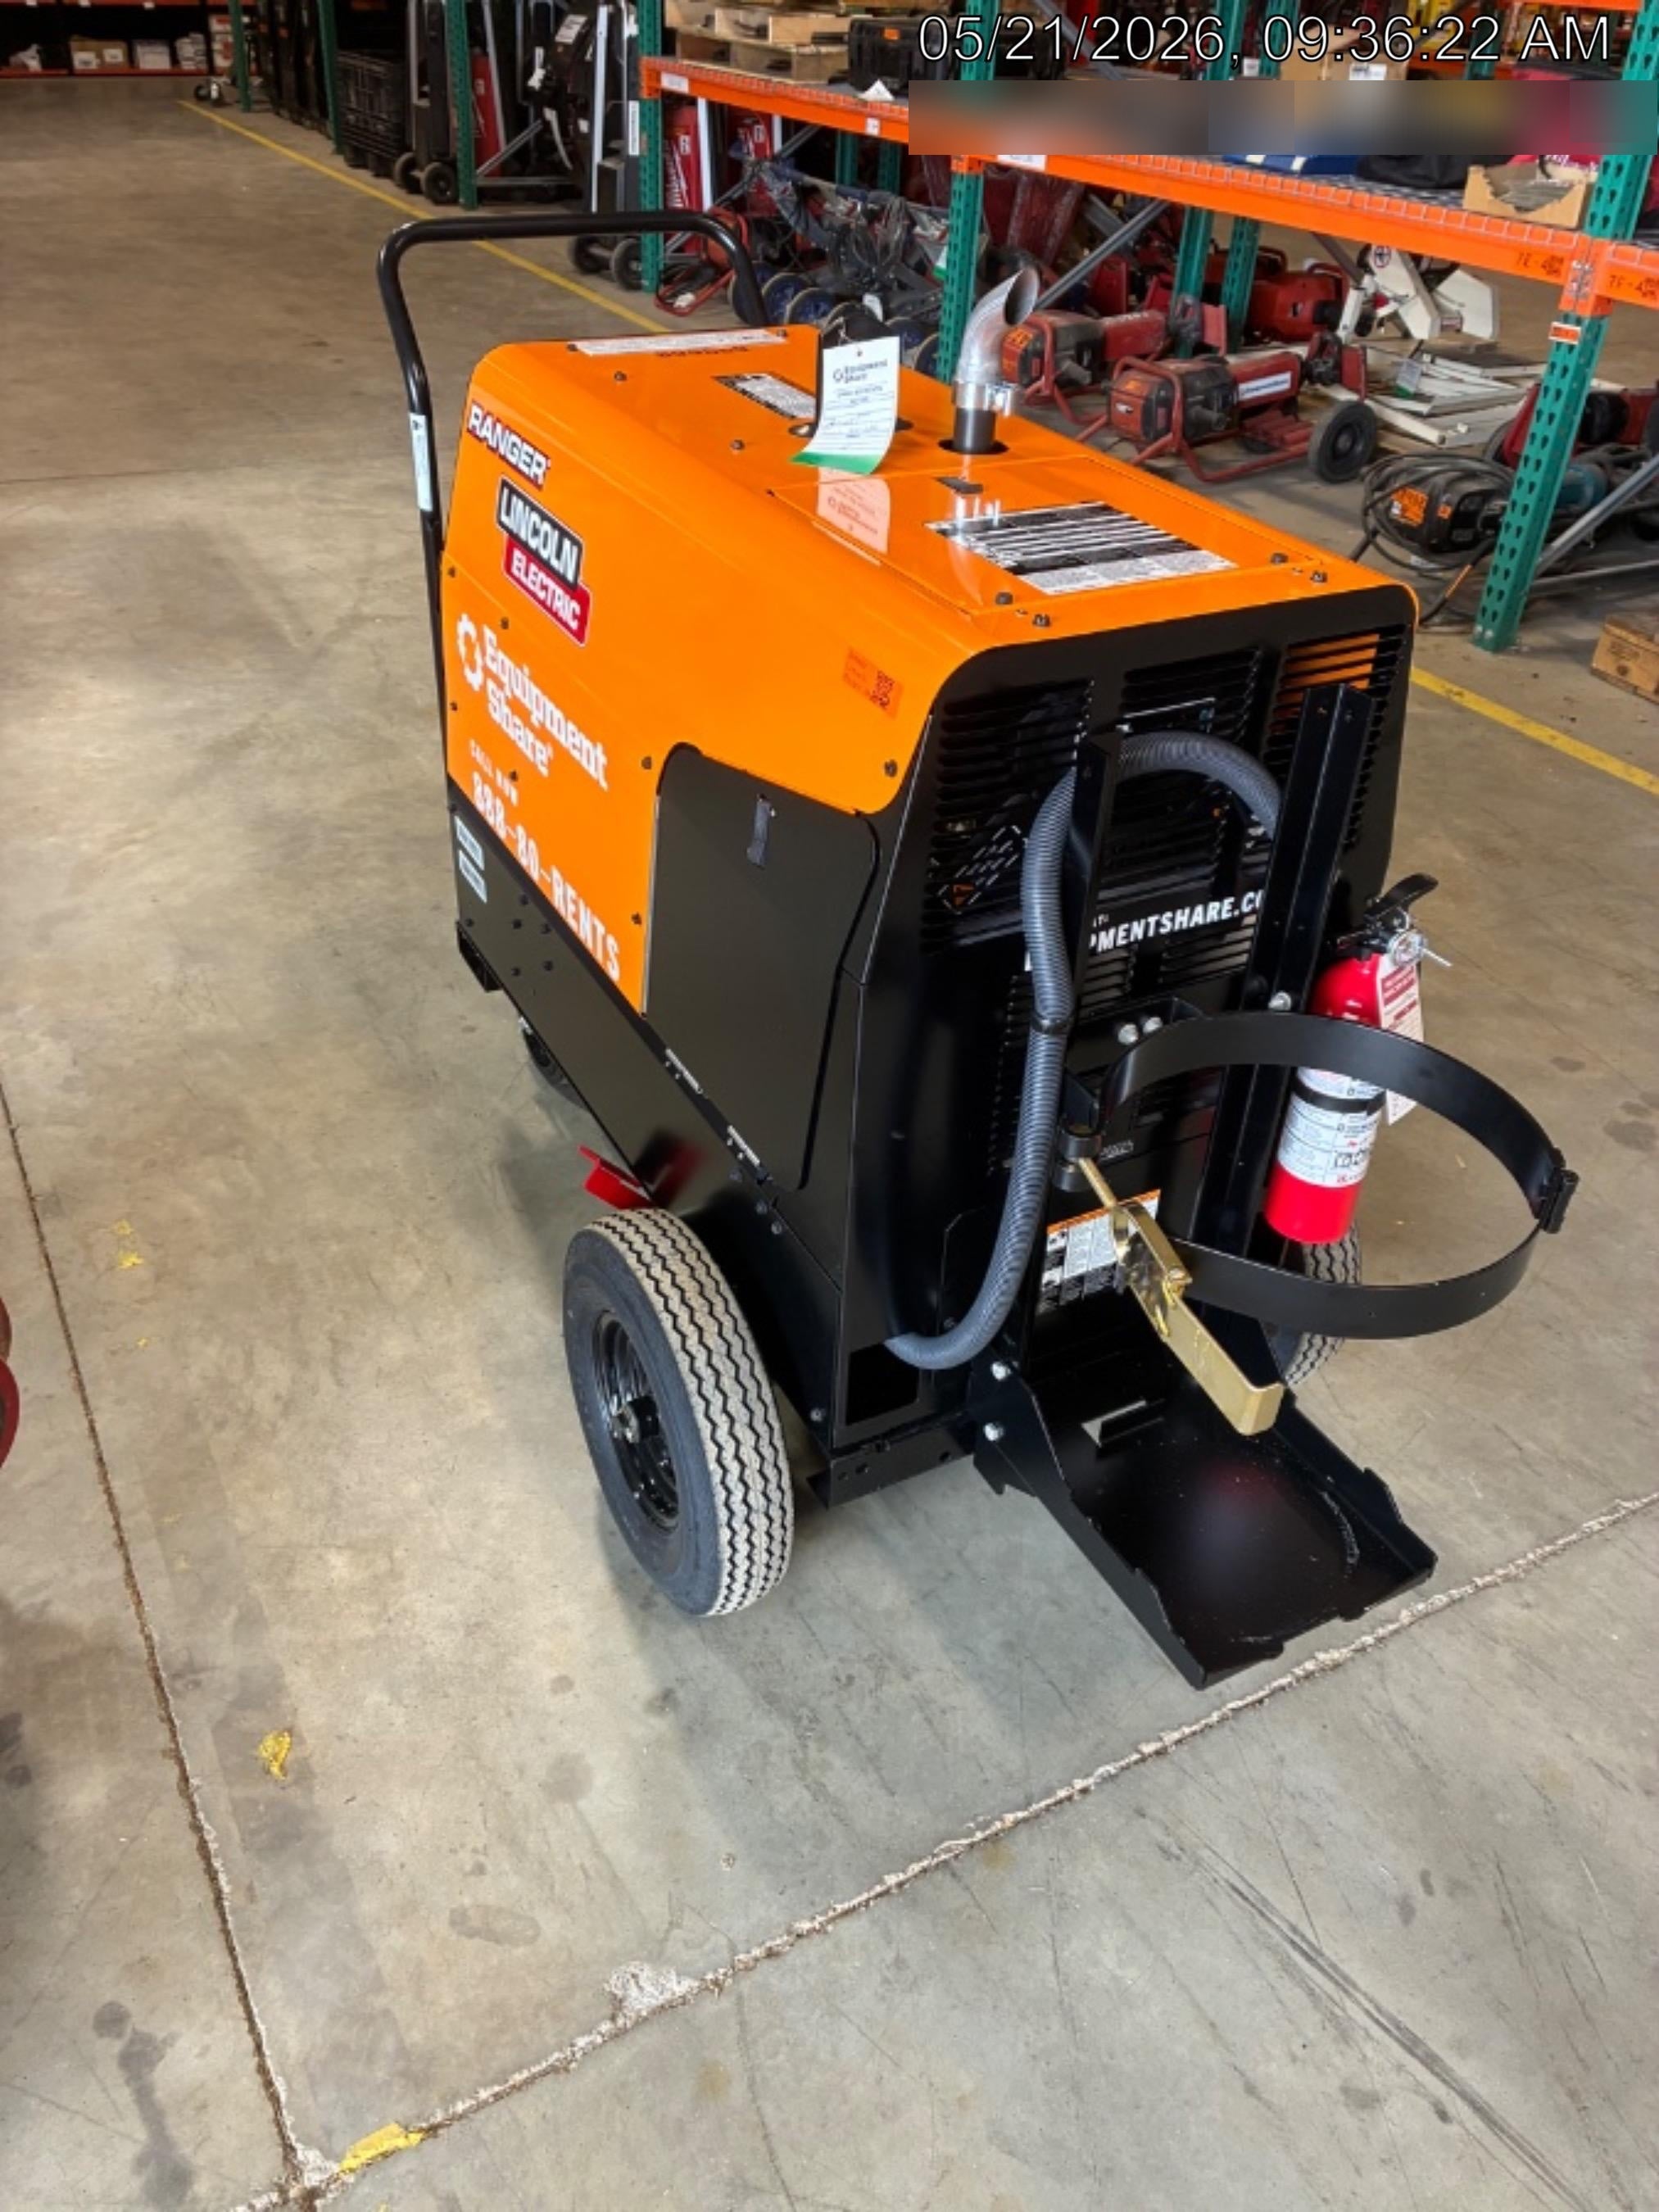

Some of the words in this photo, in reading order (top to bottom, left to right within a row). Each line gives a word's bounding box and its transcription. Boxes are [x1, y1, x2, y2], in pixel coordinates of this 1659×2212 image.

[469, 405, 548, 486] RANGER
[500, 487, 578, 584] LINCOLN
[511, 549, 582, 631] ELECTRIC
[482, 624, 608, 791] Equipment
[486, 678, 550, 777] Share
[473, 771, 622, 982] 888-80-RENTS
